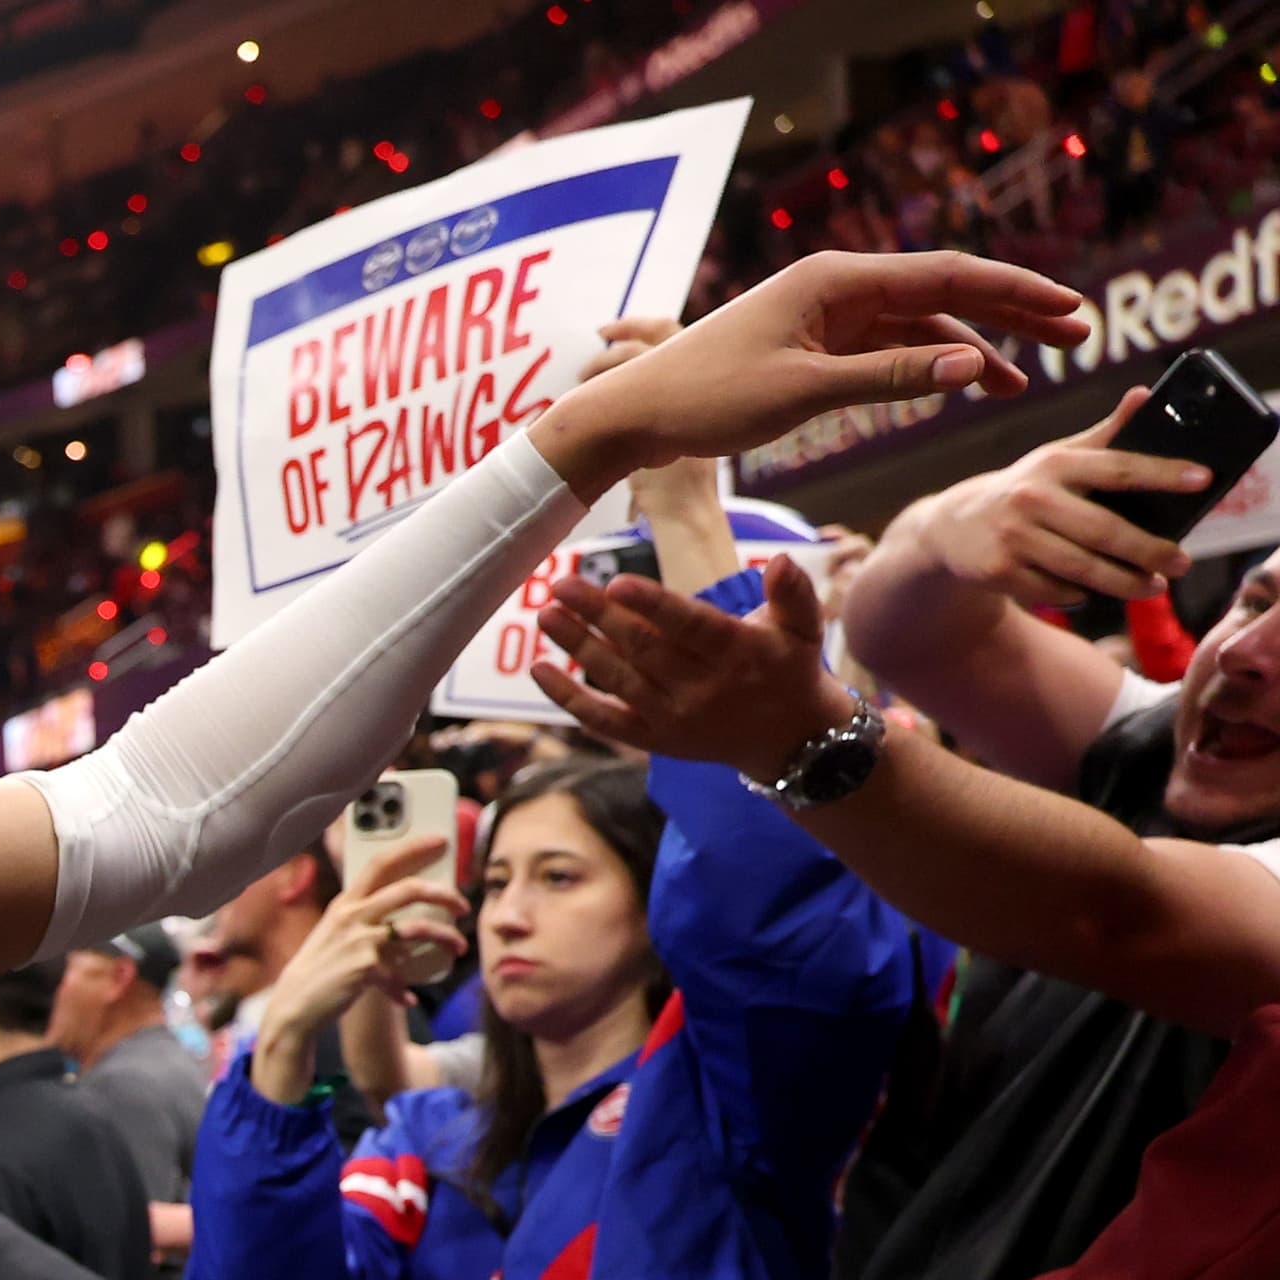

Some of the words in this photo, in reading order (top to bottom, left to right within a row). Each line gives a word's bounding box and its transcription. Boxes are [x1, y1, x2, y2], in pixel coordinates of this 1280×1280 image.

[289, 249, 552, 440] BEWARE
[281, 448, 329, 536] OF
[344, 347, 556, 526] DAWGS
